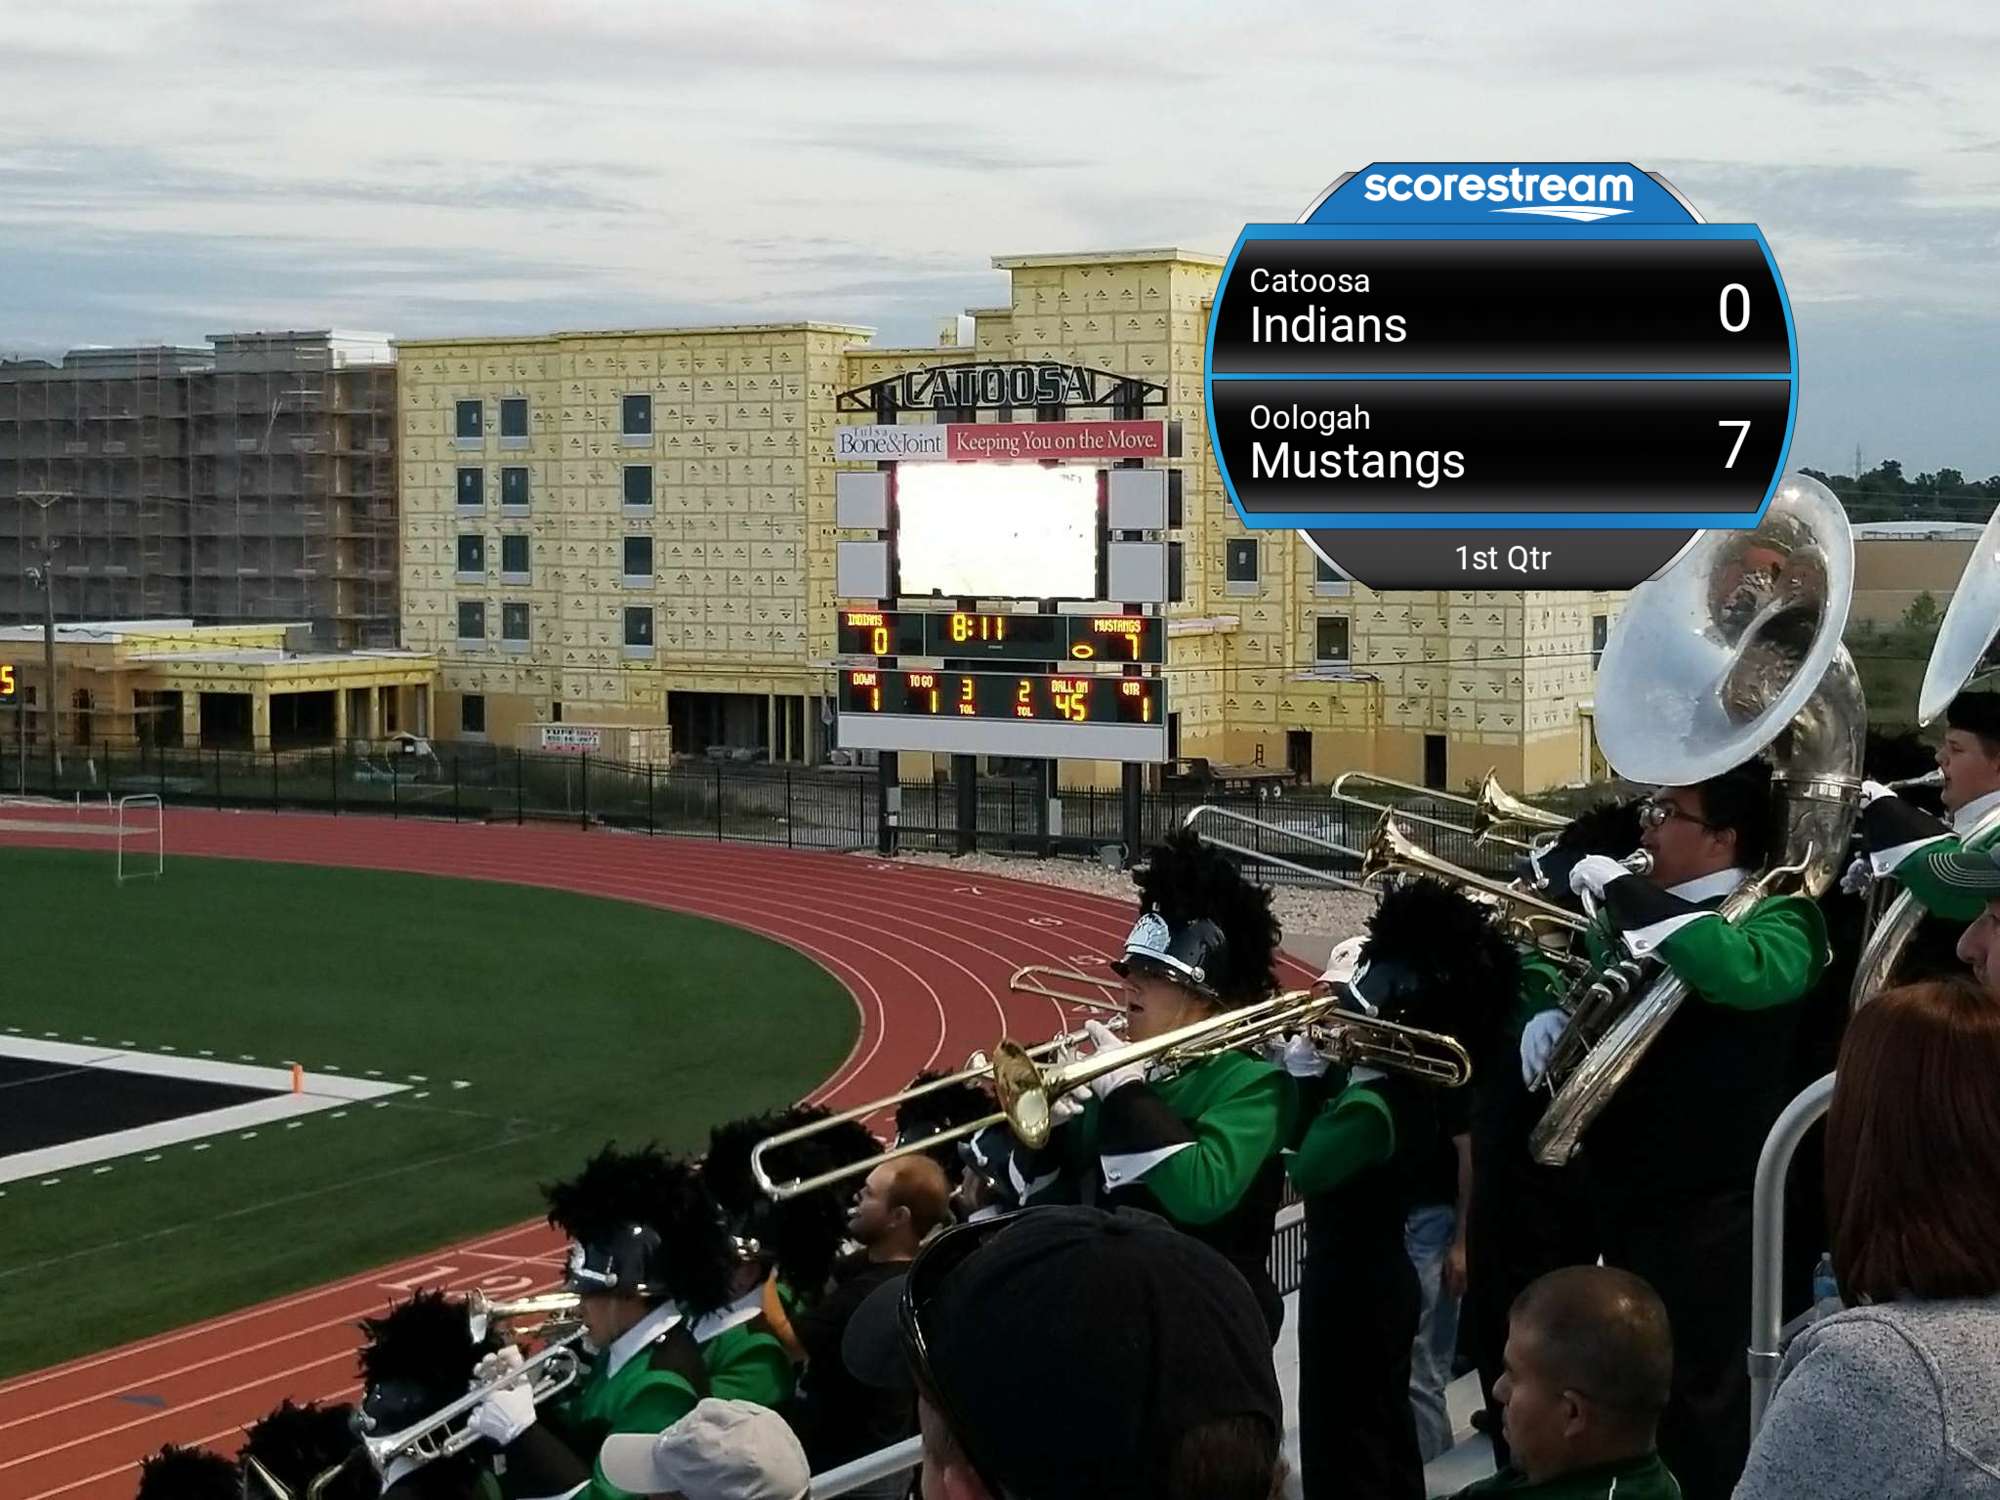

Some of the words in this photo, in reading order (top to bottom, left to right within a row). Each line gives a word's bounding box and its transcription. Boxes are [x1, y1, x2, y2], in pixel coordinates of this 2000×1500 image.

[904, 366, 1096, 407] CATOOSA
[956, 432, 1020, 456] Keeping
[1022, 431, 1051, 449] You
[1055, 434, 1076, 449] on
[1079, 429, 1104, 449] the
[1107, 429, 1158, 449] Move.
[953, 613, 1003, 641] 8:11
[1094, 619, 1141, 633] MUSTANGS
[874, 628, 888, 655] 0
[1124, 634, 1138, 661] 7
[1, 664, 15, 694] 5
[852, 672, 877, 686] DOWN
[909, 674, 920, 688] TO
[921, 675, 934, 688] GO
[962, 679, 973, 700] 3
[1122, 682, 1140, 696] QTR
[873, 688, 879, 712] 1
[932, 690, 938, 714] 1
[1018, 680, 1031, 703] 2
[959, 703, 976, 715] TOL
[1055, 693, 1085, 721] 45
[1142, 697, 1149, 723] 1
